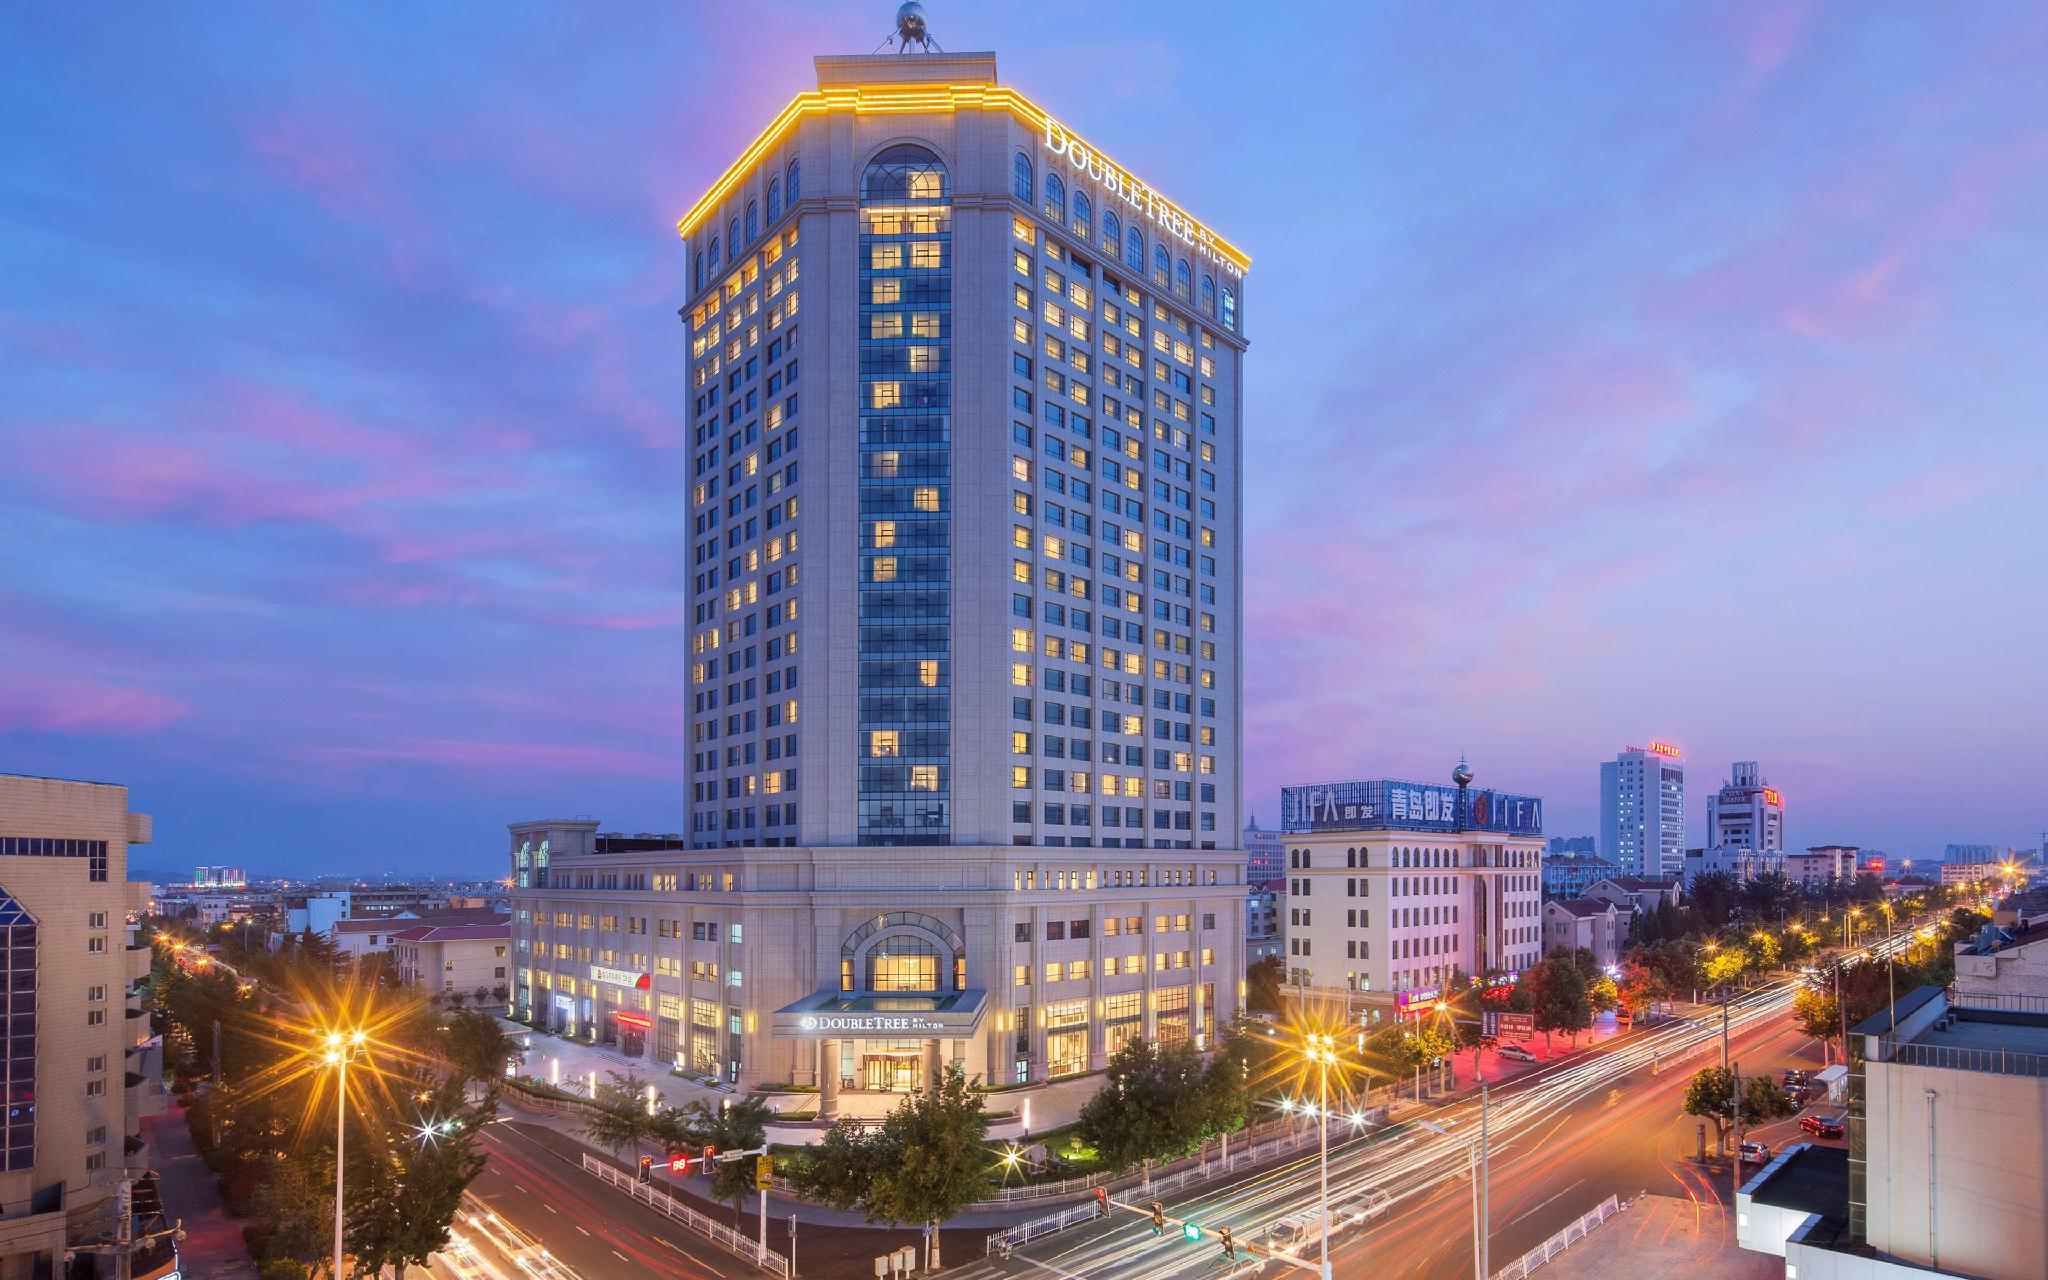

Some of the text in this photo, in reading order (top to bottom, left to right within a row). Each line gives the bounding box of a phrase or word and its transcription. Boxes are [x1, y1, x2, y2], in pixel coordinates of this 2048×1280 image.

[1044, 116, 1195, 246] DOUBLETREE
[1199, 231, 1215, 244] BY
[1199, 244, 1242, 278] HILTON
[1344, 805, 1374, 820] 即发
[1391, 789, 1454, 821] 青岛即发
[819, 1017, 909, 1029] DOUBLETREE
